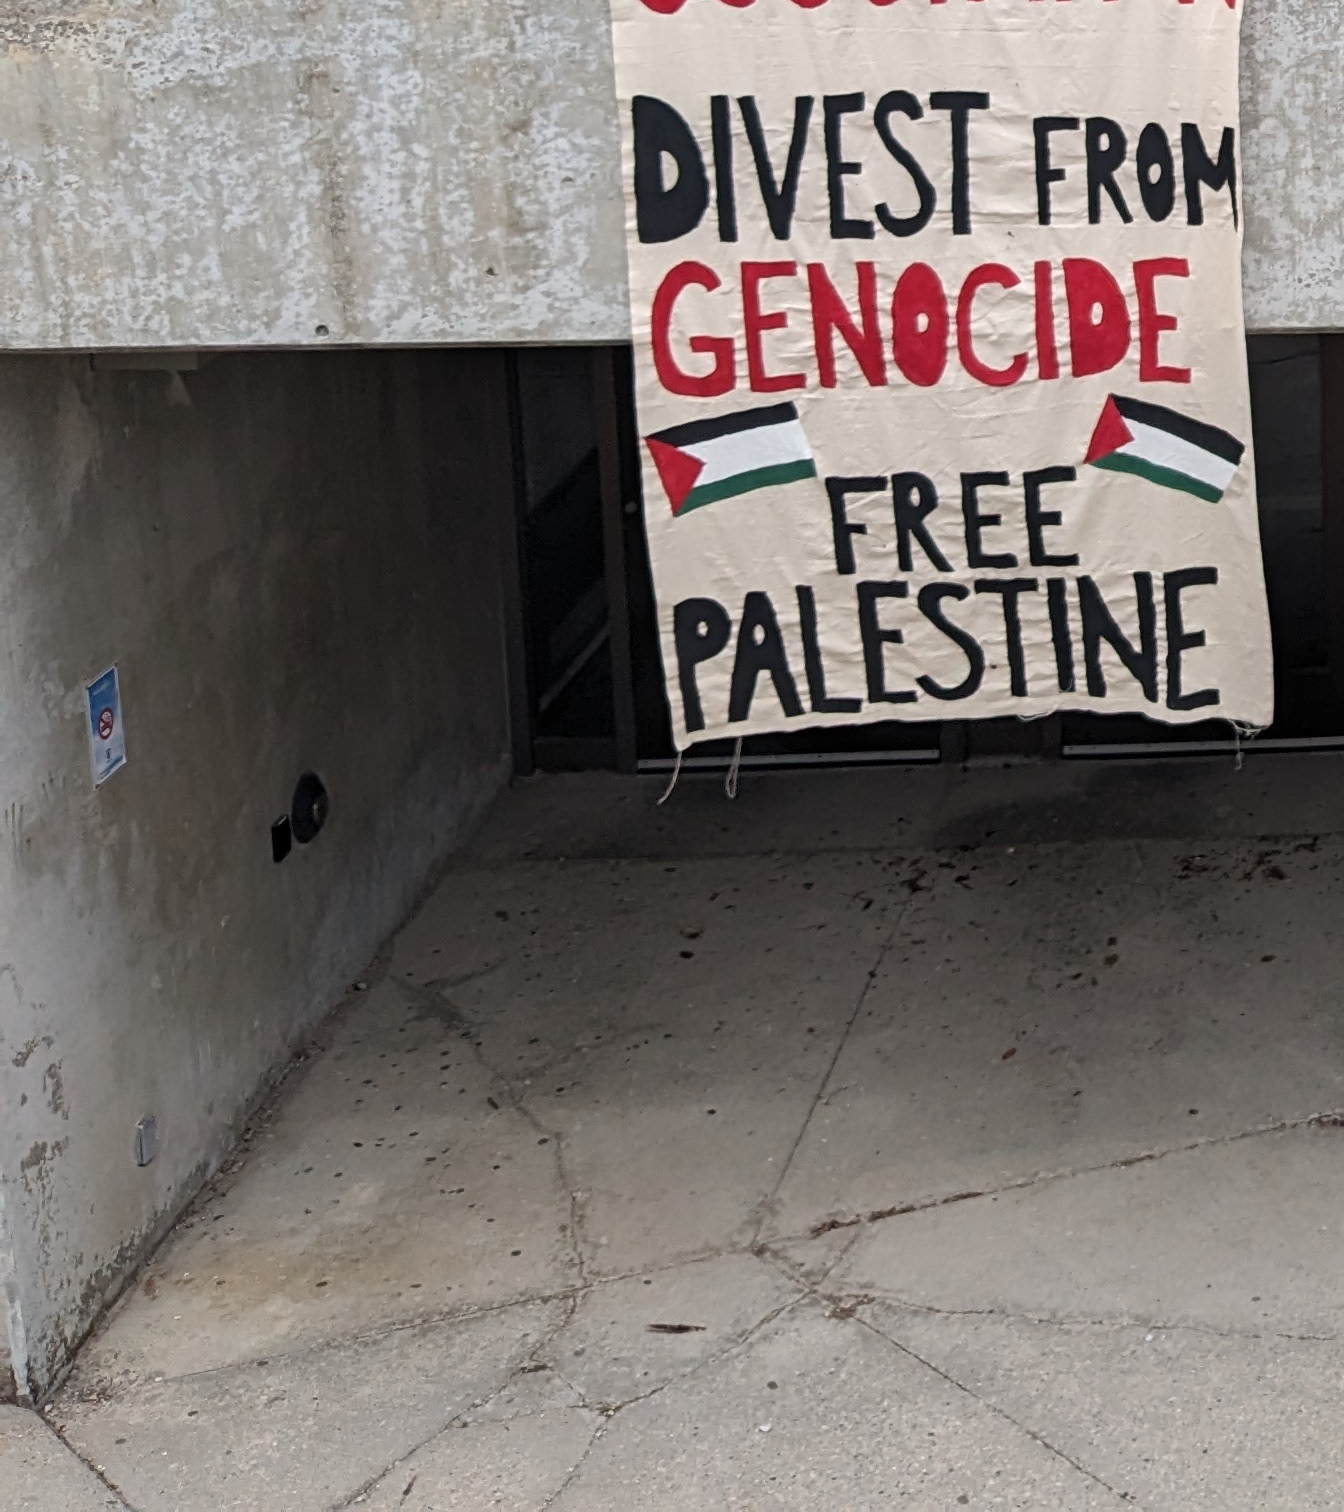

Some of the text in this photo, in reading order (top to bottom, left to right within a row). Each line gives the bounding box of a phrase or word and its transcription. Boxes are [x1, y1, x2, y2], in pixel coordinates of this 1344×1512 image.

[631, 90, 1239, 243] DIVEST FROM
[652, 257, 1191, 397] GENOCIDE
[825, 465, 1079, 575] FREE
[673, 566, 1221, 732] PALESTINE
